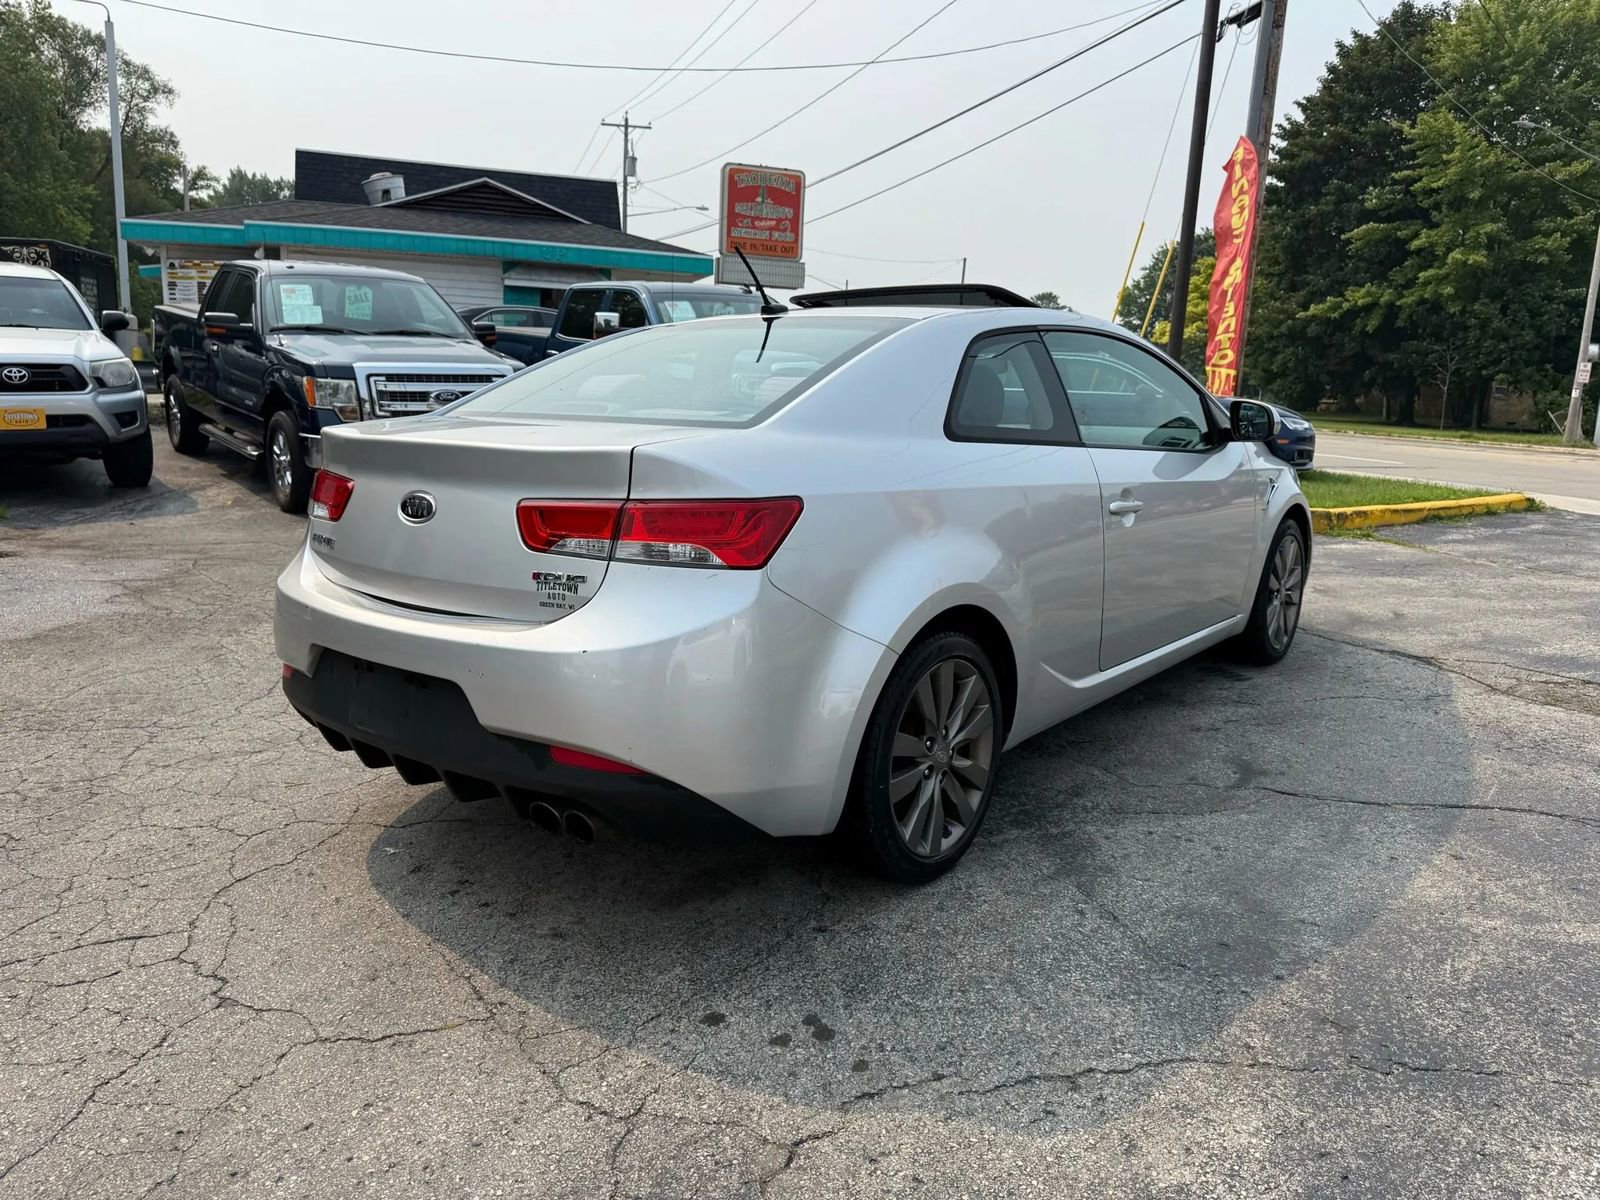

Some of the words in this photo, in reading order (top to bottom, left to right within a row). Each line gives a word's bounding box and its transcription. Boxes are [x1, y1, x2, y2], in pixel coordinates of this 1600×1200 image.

[735, 172, 796, 194] TAQUERIA
[731, 228, 770, 240] MEXICAN
[772, 231, 795, 242] FOOD
[730, 241, 747, 249] DINE
[780, 245, 794, 254] OUT
[347, 291, 370, 305] SALE
[438, 392, 456, 401] Ford
[405, 498, 428, 517] KIA
[536, 582, 578, 595] TITLETOWN
[548, 593, 566, 602] AUTO
